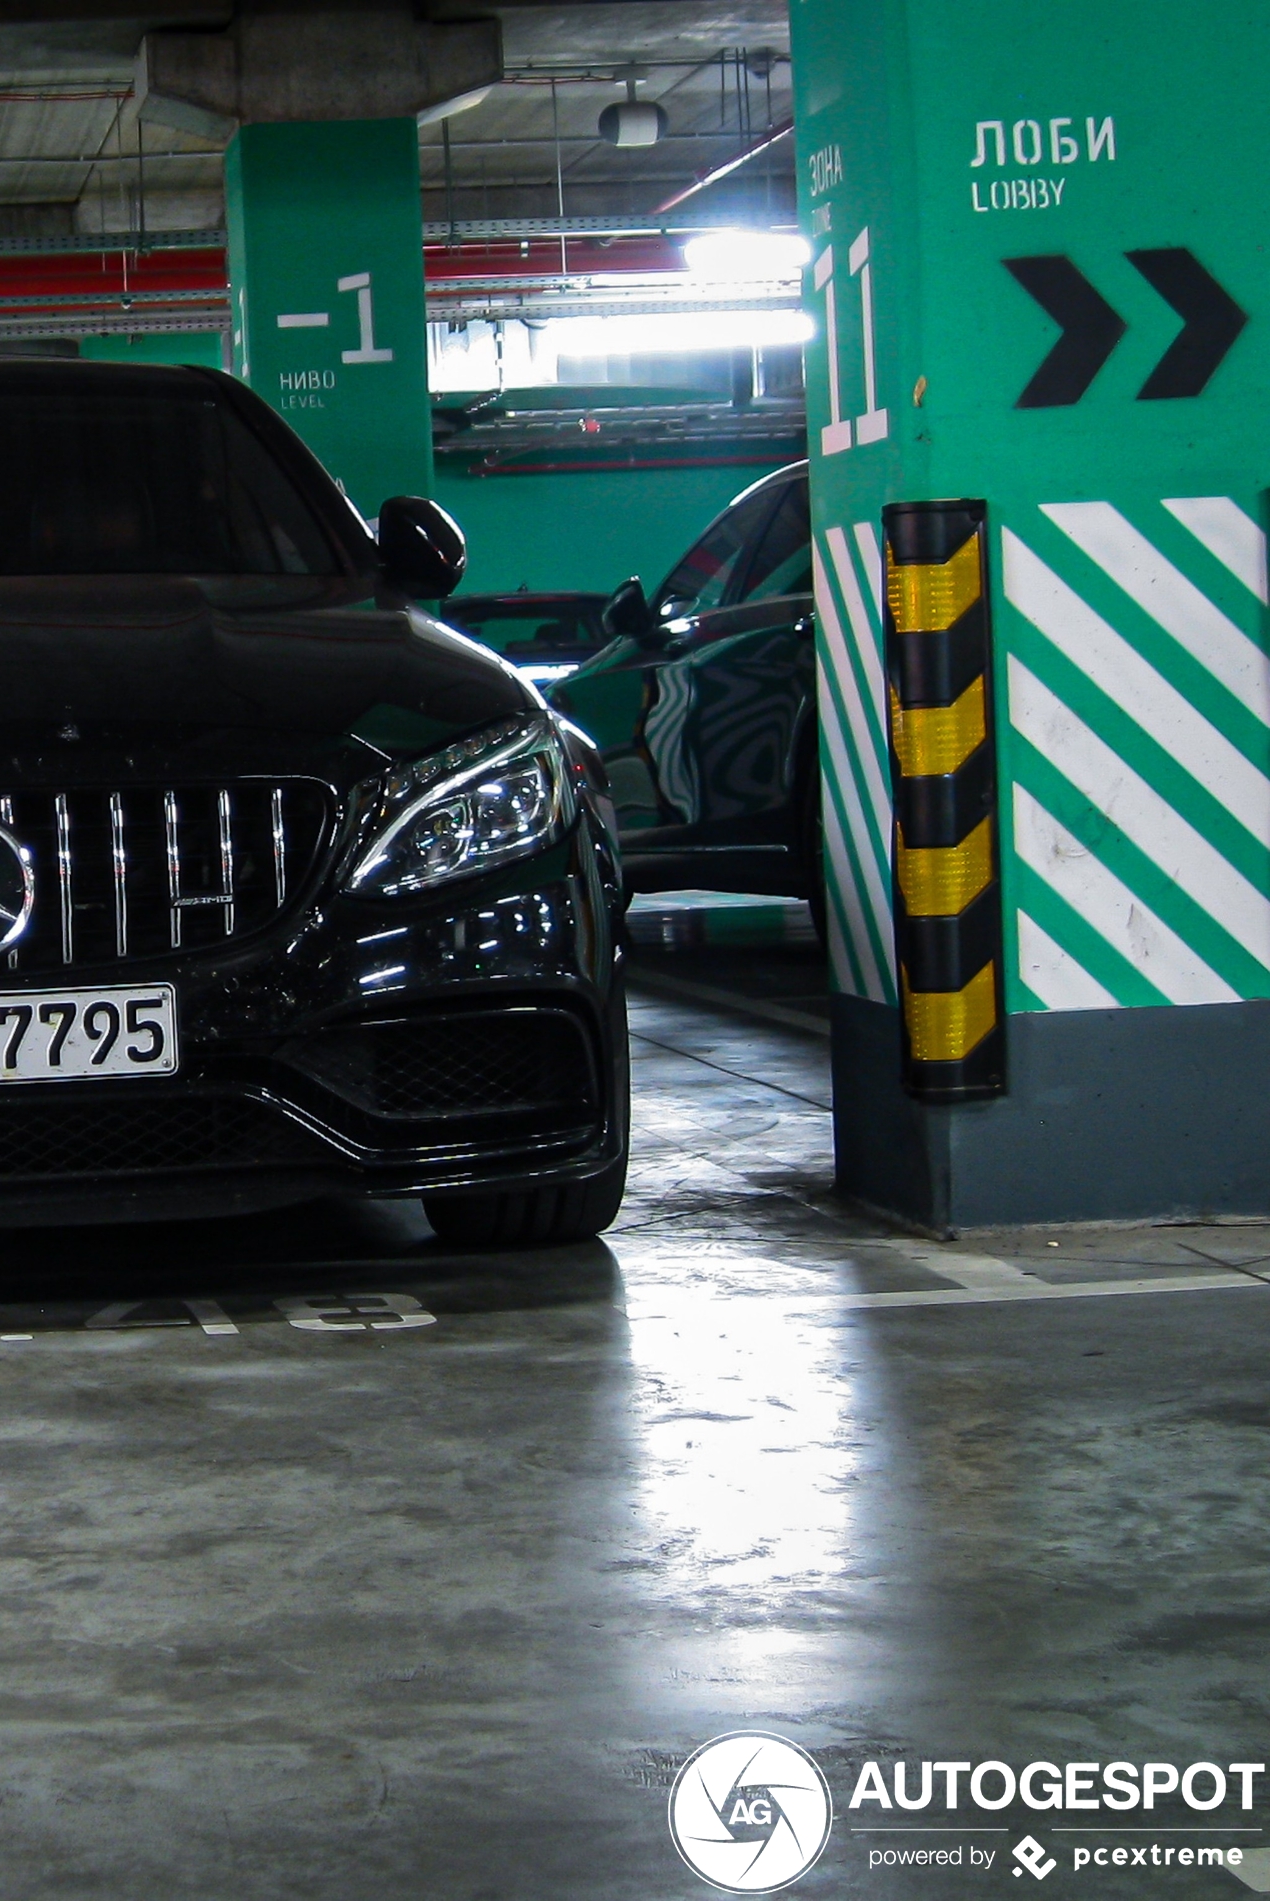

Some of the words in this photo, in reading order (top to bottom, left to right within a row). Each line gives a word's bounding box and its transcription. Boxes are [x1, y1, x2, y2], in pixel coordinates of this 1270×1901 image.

[970, 116, 1116, 168] ЛОБИ
[809, 144, 843, 197] ЗОНА
[971, 178, 1066, 212] LOBBY
[277, 272, 393, 364] -1
[814, 226, 888, 456] 11
[279, 369, 336, 390] НИВО
[281, 394, 325, 410] LEVEL
